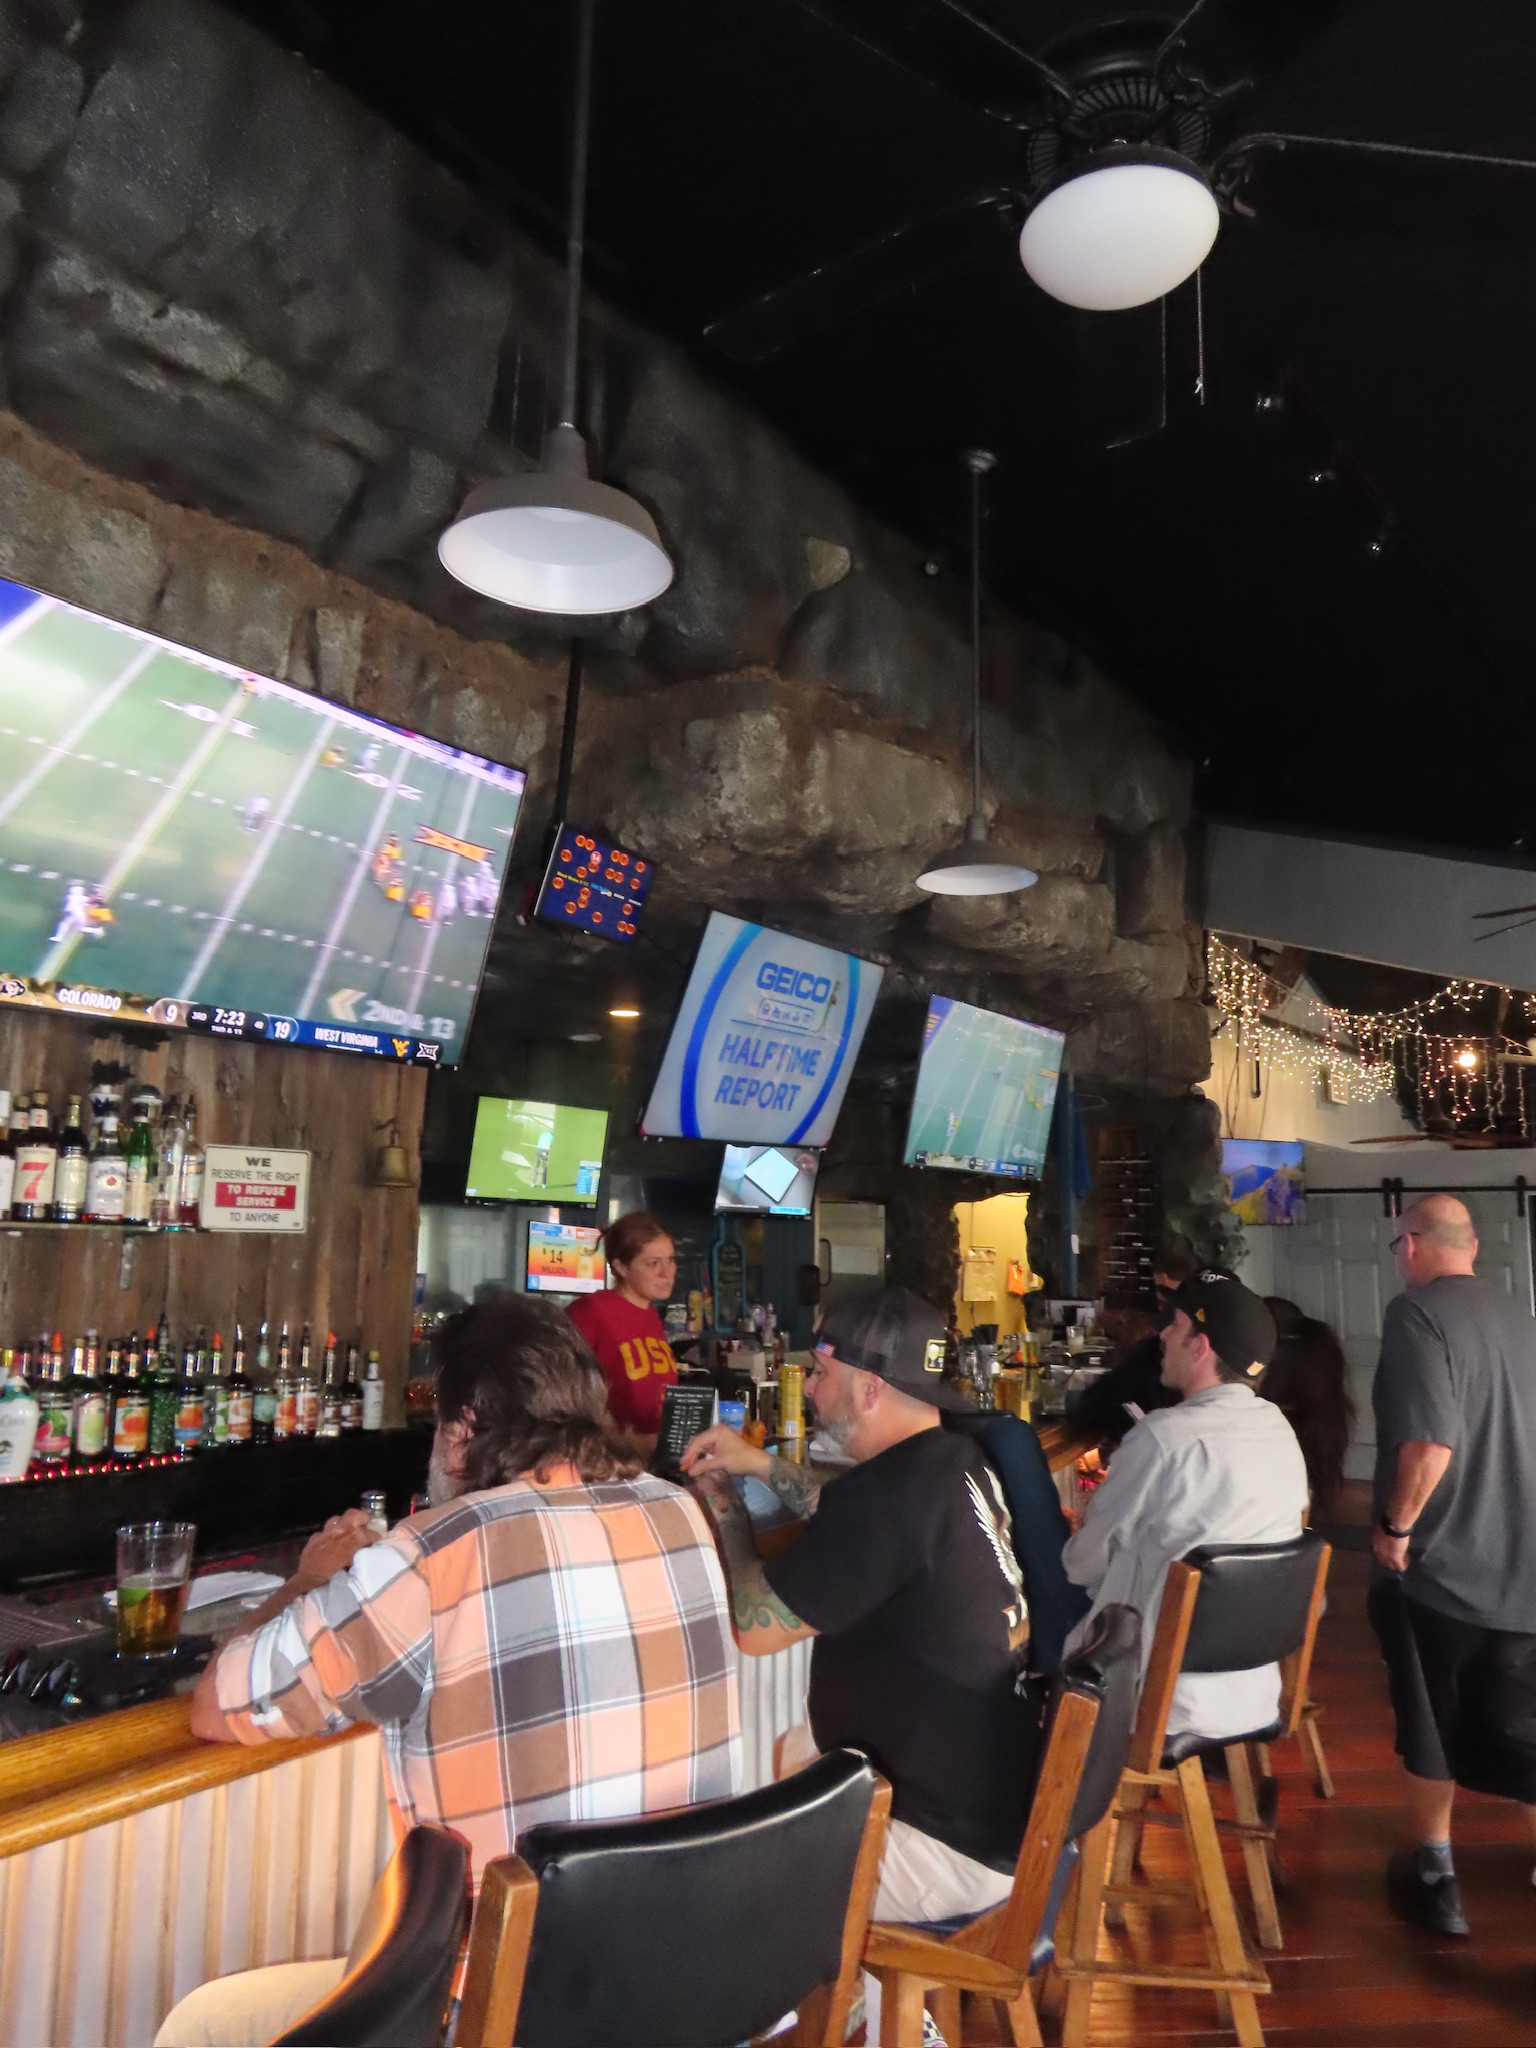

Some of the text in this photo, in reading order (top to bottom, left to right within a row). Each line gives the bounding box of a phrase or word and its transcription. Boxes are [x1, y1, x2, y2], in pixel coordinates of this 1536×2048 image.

[756, 961, 831, 1004] GEICO
[58, 987, 122, 1011] COLORADO
[165, 1004, 178, 1023] 9
[213, 1008, 246, 1027] 7:23
[274, 1021, 291, 1039] 19
[314, 1027, 379, 1048] WEST VIRGINIA
[430, 1017, 456, 1040] 13
[718, 1033, 821, 1077] HALFTIME
[713, 1074, 802, 1112] REPORT
[246, 1157, 271, 1167] WE
[21, 1161, 49, 1199] 7
[211, 1169, 300, 1182] RESERVE THE RIGHT
[227, 1184, 286, 1196] TO REFUSE
[236, 1196, 276, 1207] SERVICE
[229, 1212, 280, 1223] TO ANYONE
[550, 1249, 563, 1264] 14
[541, 1266, 568, 1275] MILLION
